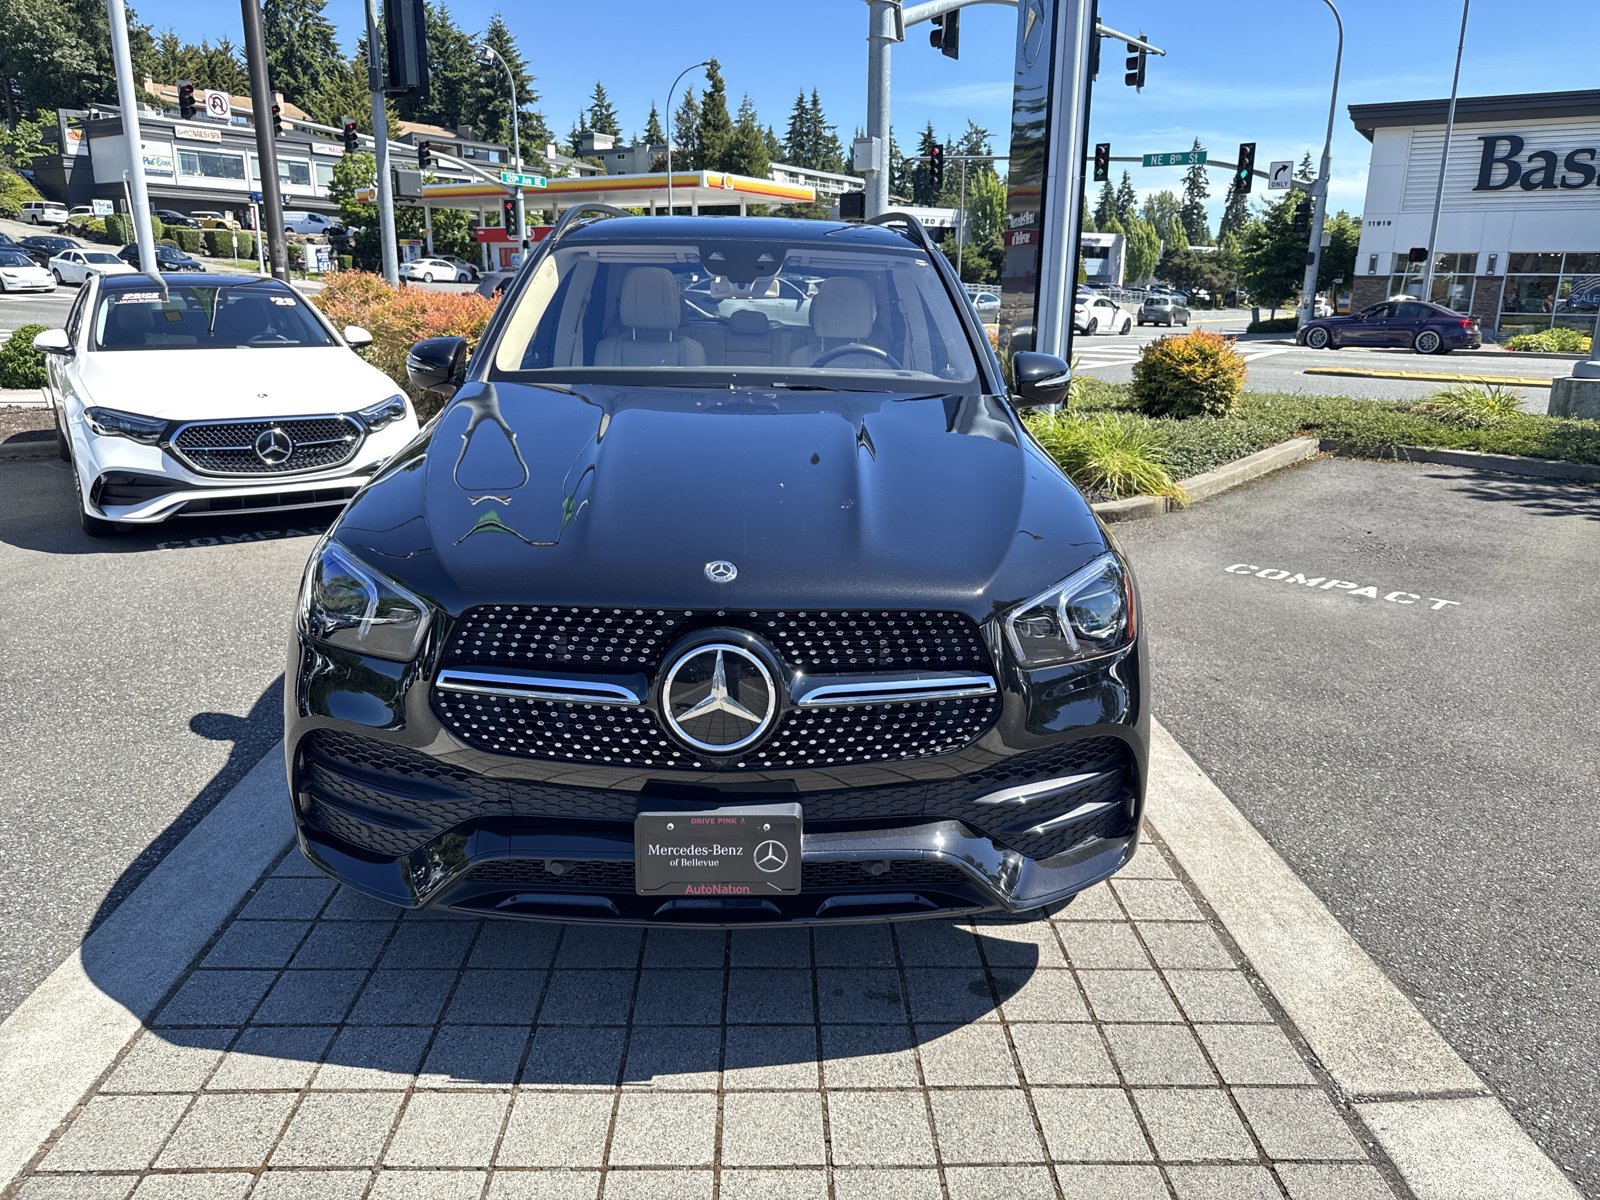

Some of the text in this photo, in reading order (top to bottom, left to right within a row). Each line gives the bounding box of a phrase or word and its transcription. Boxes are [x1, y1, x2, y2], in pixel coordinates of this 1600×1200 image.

[1151, 153, 1198, 165] NE 8th St
[1472, 135, 1600, 191] Bas
[1572, 294, 1600, 303] SALE
[1224, 563, 1461, 610] COMPACT
[648, 844, 743, 856] Mercedes-Benz
[670, 858, 720, 867] of Bellevue
